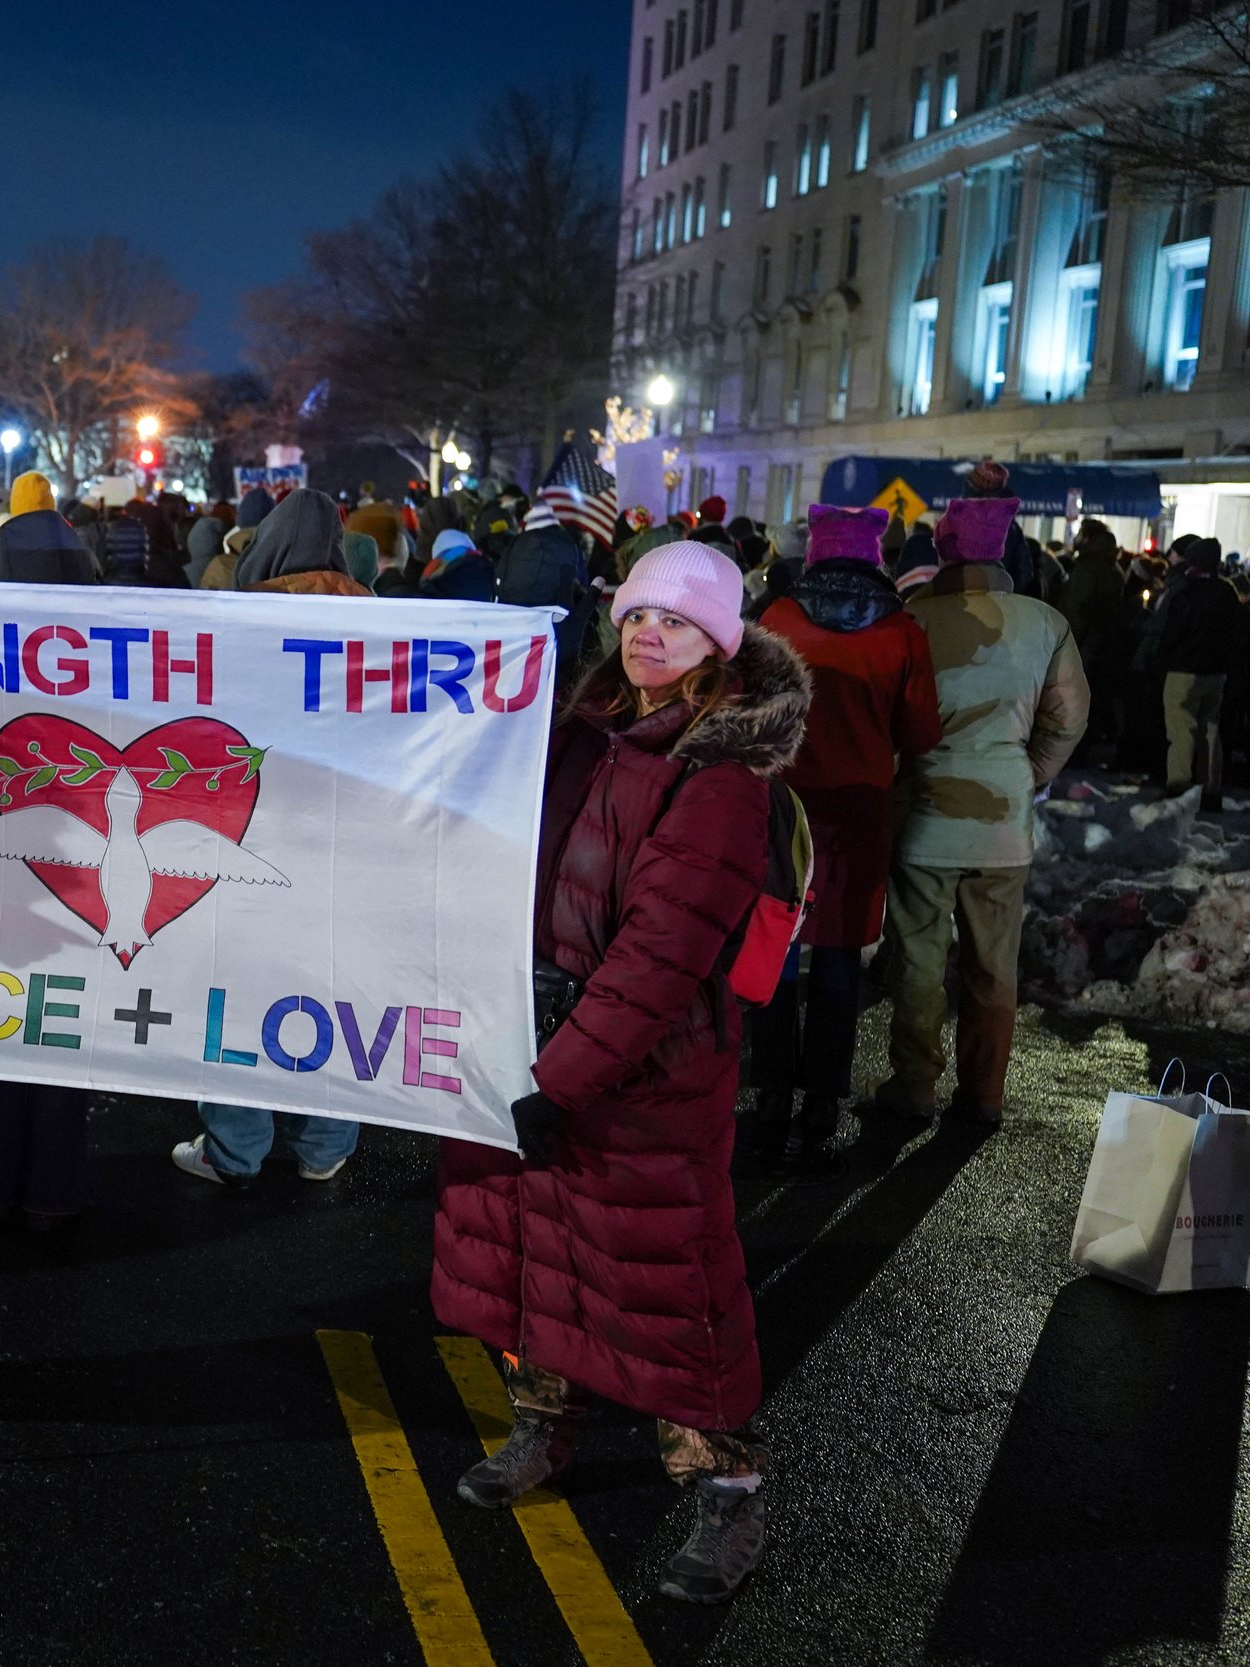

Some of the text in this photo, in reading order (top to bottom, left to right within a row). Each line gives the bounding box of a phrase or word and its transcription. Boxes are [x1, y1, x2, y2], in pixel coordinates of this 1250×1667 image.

[282, 634, 548, 714] THRU
[114, 988, 172, 1045] +
[203, 987, 462, 1095] LOVE
[1175, 1213, 1244, 1230] BOUCHERIE
